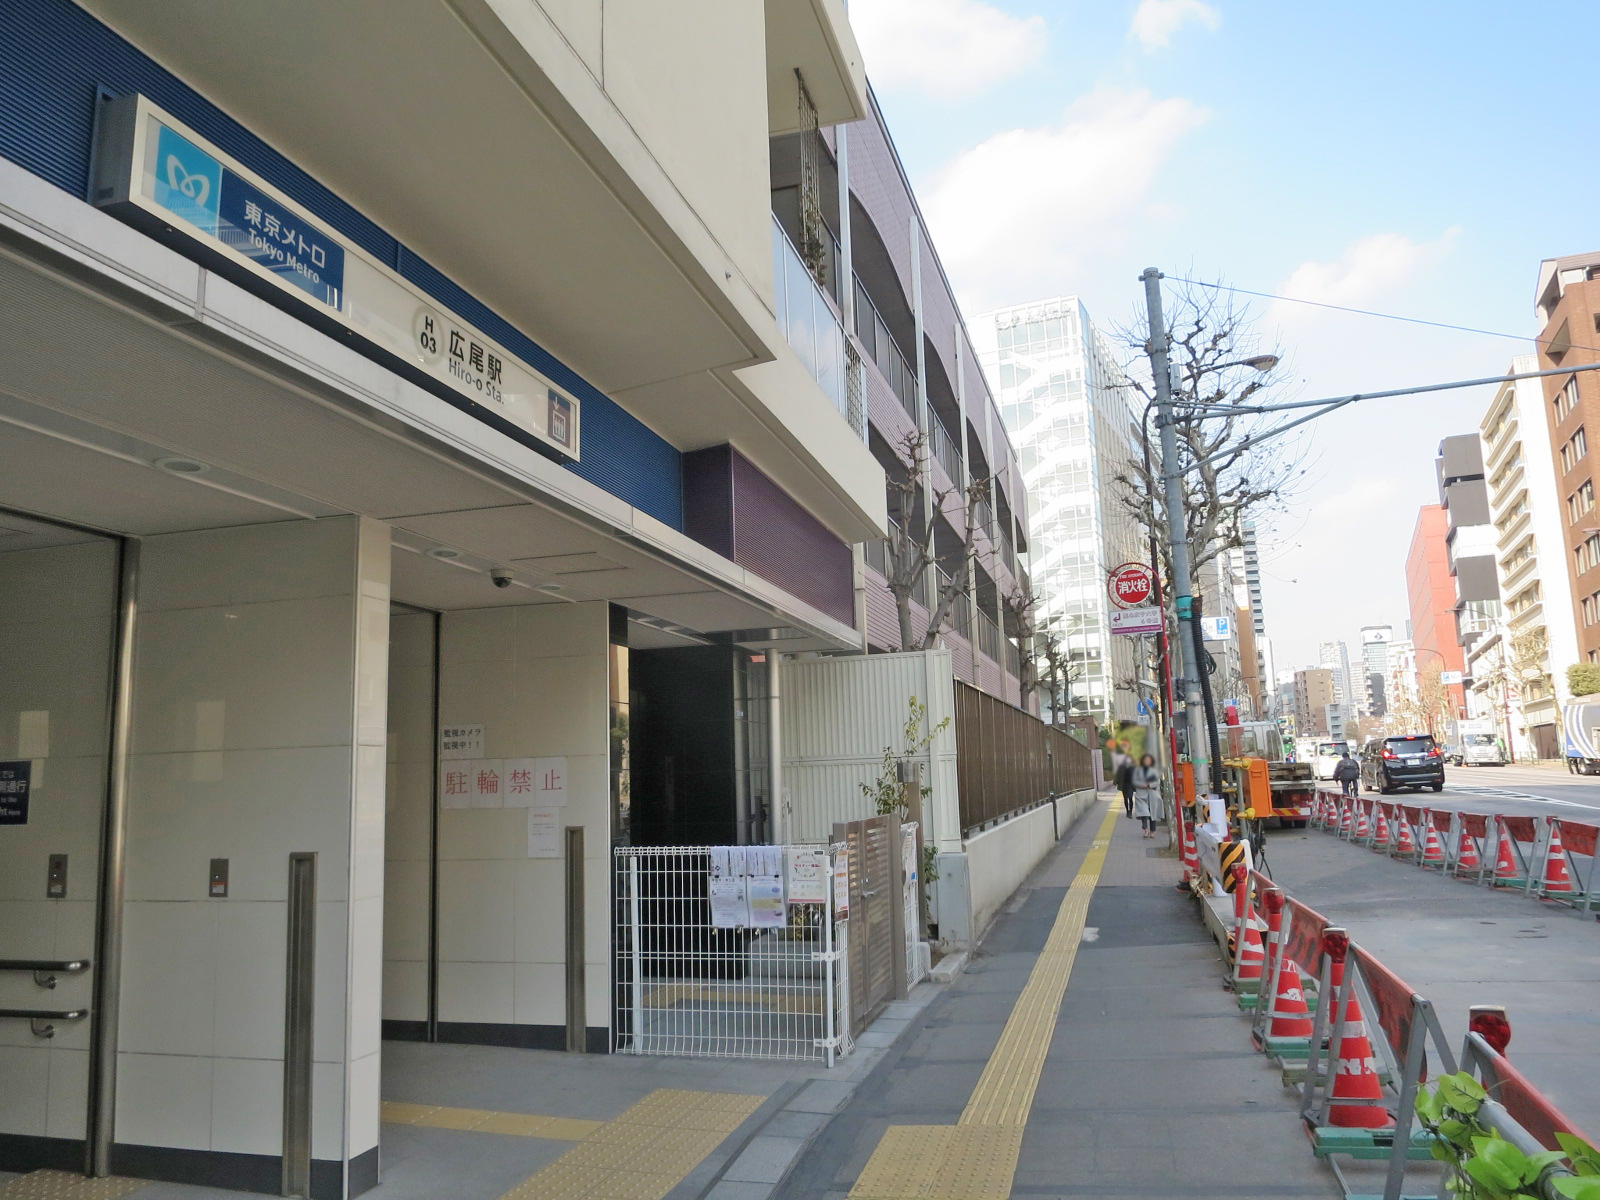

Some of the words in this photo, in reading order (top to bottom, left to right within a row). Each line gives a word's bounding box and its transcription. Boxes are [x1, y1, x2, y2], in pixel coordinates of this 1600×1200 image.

[244, 200, 326, 269] 東京メトロ
[248, 227, 284, 262] Tokyo
[286, 252, 320, 284] Metro
[424, 315, 434, 334] H
[420, 332, 437, 355] 03
[448, 329, 502, 385] 広尾駅
[448, 358, 483, 391] Hiro-o
[485, 382, 505, 405] Sta.
[1117, 578, 1149, 595] 消火栓
[443, 729, 481, 738] 監視カメラ
[445, 768, 562, 795] 駐輪禁止
